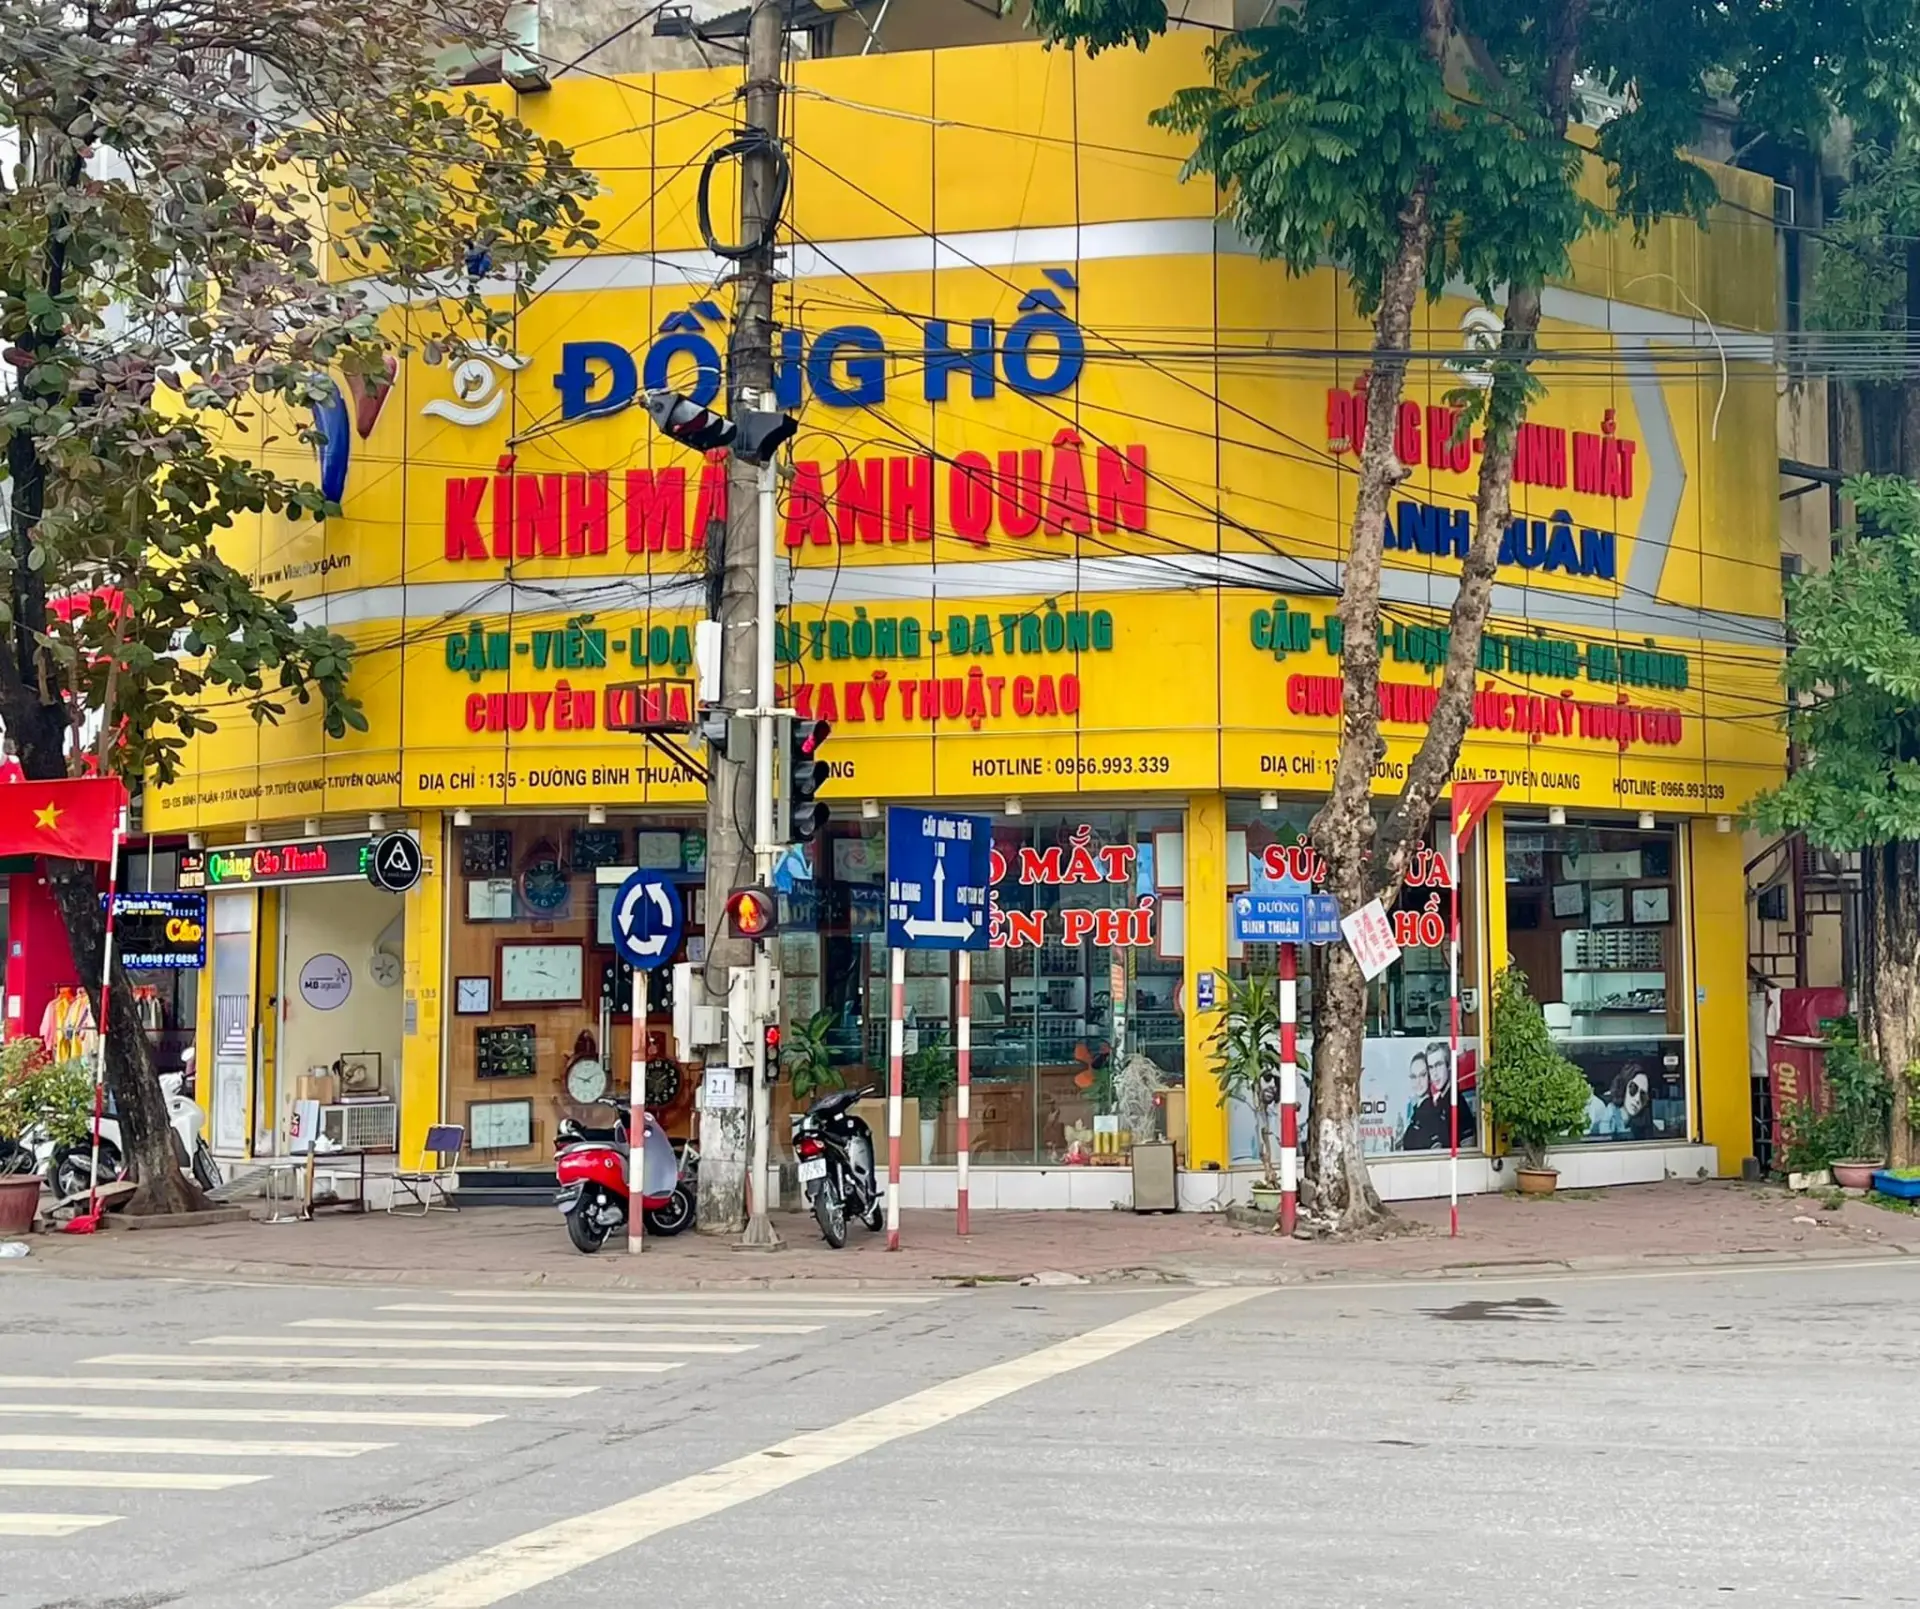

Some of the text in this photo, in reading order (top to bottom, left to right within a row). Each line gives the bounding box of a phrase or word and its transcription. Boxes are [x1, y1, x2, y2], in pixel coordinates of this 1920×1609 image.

[924, 268, 1084, 401] HỒ
[1573, 408, 1636, 498] MẮT
[445, 453, 609, 561] KÍNH
[784, 456, 934, 548] ANH
[950, 428, 1147, 548] QUÂN
[1000, 598, 1114, 655] TRÒNG
[465, 679, 597, 733] CHUYÊN
[900, 664, 1006, 731] THUẬT
[1012, 673, 1081, 717] CAO
[488, 772, 517, 789] 135
[592, 764, 629, 785] BÌNH
[972, 758, 1043, 778] HOTLINE
[1055, 756, 1170, 775] 0966.993.339
[1500, 766, 1538, 788] TUYÊN
[1541, 771, 1580, 790] QUANG
[1612, 777, 1657, 796] HOTLINE
[1018, 824, 1136, 885] MẮT
[1061, 896, 1156, 947] PHÍ
[1393, 892, 1446, 948] HỒ
